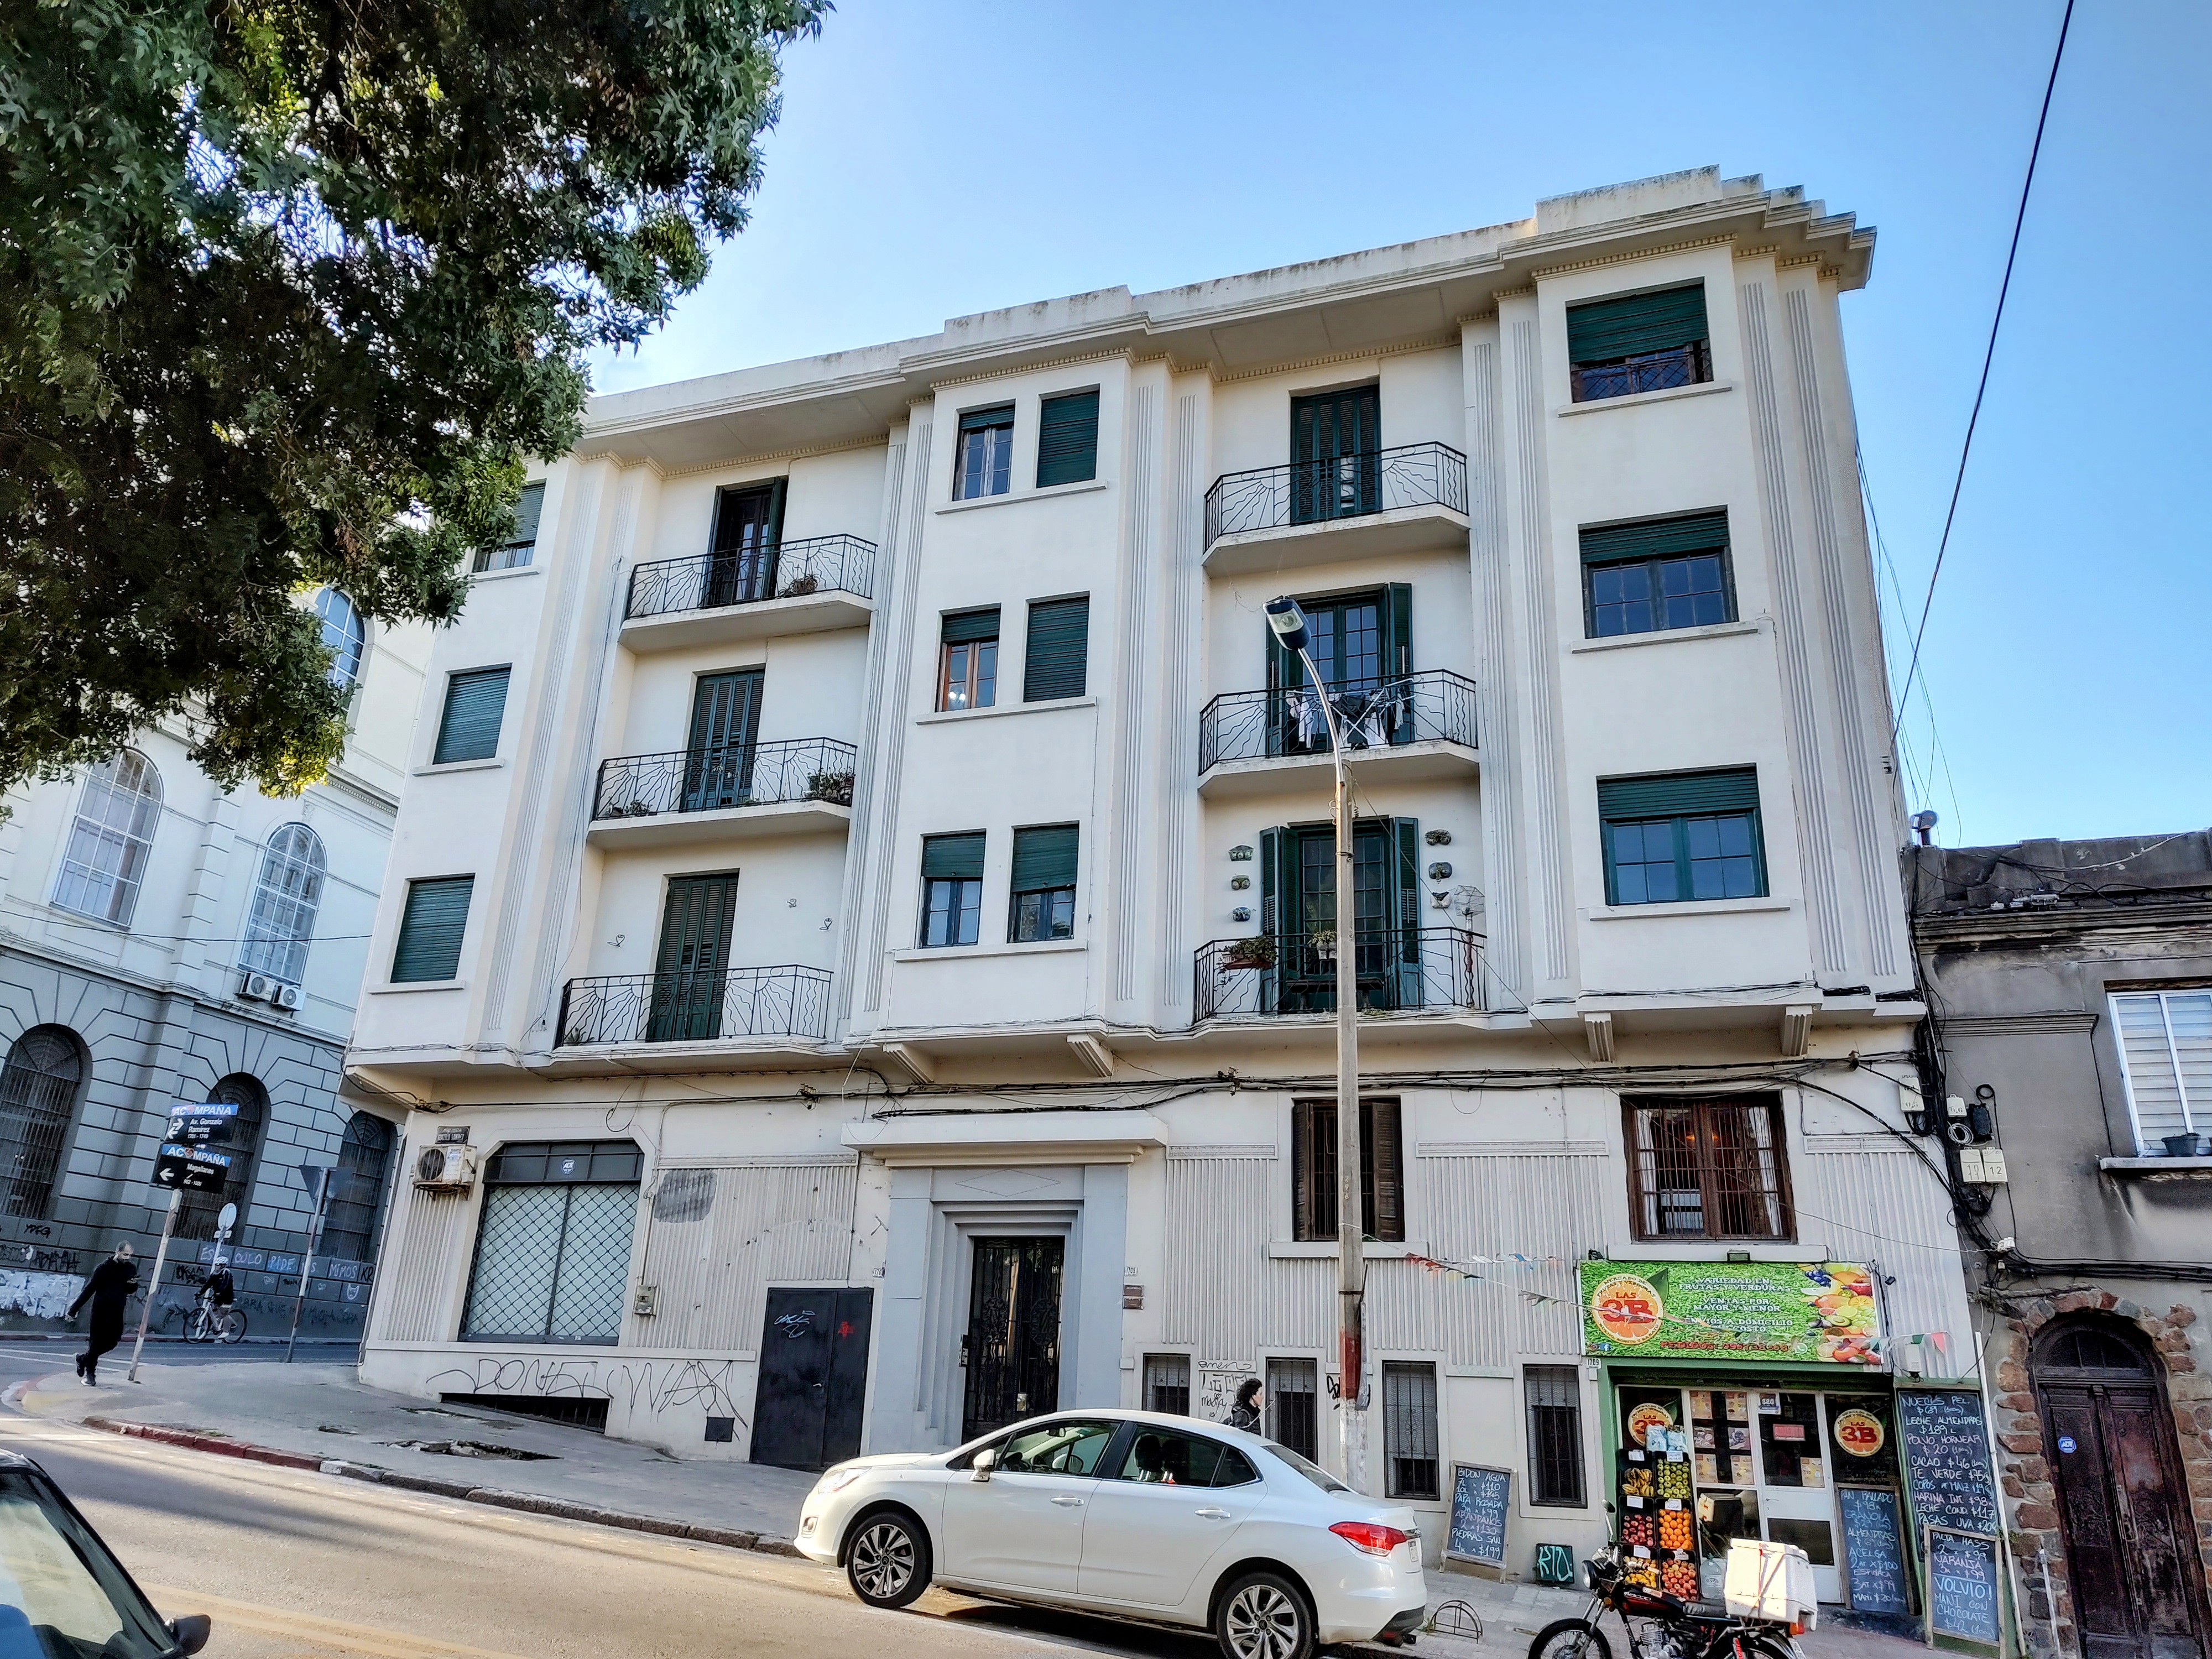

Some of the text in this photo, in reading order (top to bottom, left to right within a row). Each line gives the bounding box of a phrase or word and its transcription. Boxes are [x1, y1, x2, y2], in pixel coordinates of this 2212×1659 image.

[186, 1163, 215, 1175] Magallanes
[1990, 1166, 2002, 1176] 12
[329, 1263, 357, 1279] MIMOS
[1906, 1416, 1983, 1426] LECHE ALMENDRAS
[1841, 1426, 1877, 1443] 3B
[1919, 1425, 1948, 1435] $189
[1906, 1433, 1983, 1445] POLVO HORNEAR
[1911, 1455, 1940, 1467] CACAO
[1948, 1455, 1970, 1469] $46
[1458, 1467, 1506, 1482] BIDON AGUA
[1911, 1467, 1925, 1479] TE
[1931, 1468, 1963, 1480] VERDE
[1481, 1481, 1501, 1491] $110
[1912, 1479, 1936, 1490] COPOS
[1454, 1493, 1504, 1510] PAPA ROSADA
[1914, 1491, 1945, 1504] HARINA
[1454, 1510, 1503, 1527] ARANDANOS
[1844, 1509, 1892, 1524] GRANOLA
[1916, 1503, 1941, 1513] LECHE
[1971, 1505, 1995, 1520] $117
[1918, 1512, 1949, 1526] PASAS
[1956, 1517, 1975, 1531] UVA
[1452, 1527, 1483, 1542] PIEDRAS
[1847, 1526, 1896, 1542] ALMENDRAS
[1932, 1531, 1990, 1550] PALTA HASS
[1478, 1543, 1500, 1559] $199
[1849, 1547, 1887, 1559] ACELGA
[1938, 1543, 1948, 1556] 2
[1933, 1552, 1984, 1572] NARANJA
[1969, 1600, 1988, 1610] CON
[1937, 1604, 1990, 1624] CHOCOLATE
[1944, 1617, 1969, 1633] $42
